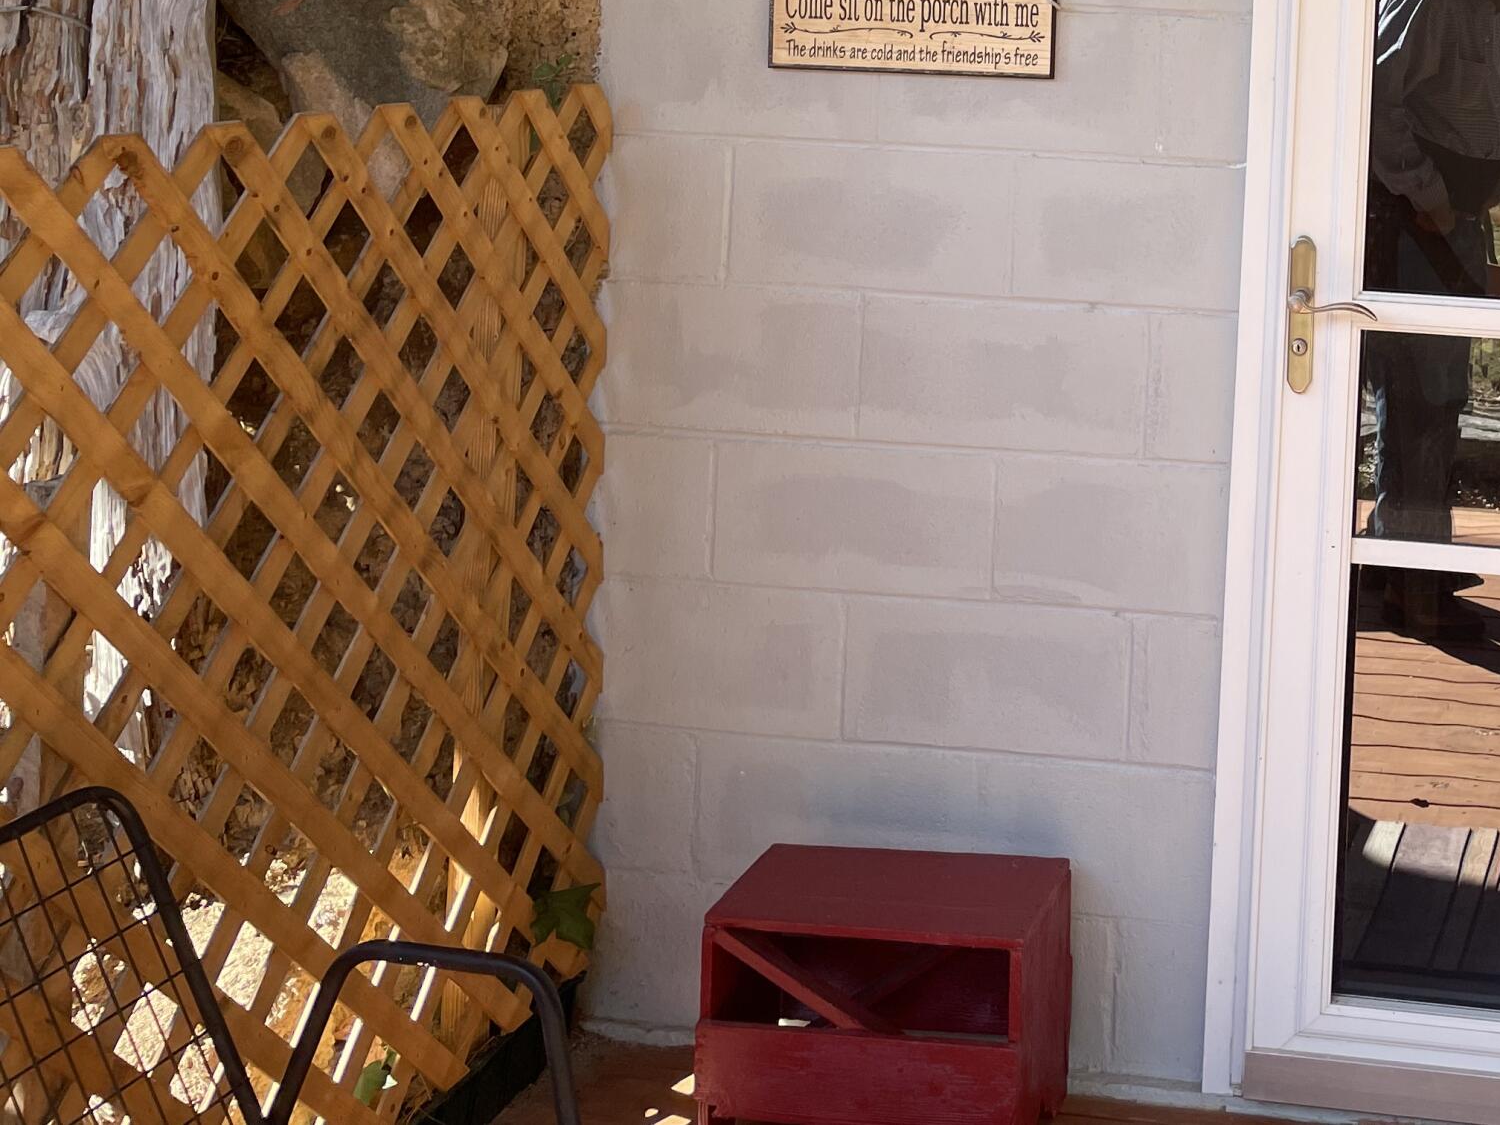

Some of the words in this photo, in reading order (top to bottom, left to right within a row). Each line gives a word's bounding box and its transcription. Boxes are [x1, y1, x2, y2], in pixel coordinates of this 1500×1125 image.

[1015, 3, 1039, 28] me
[786, 39, 806, 58] The
[809, 39, 846, 59] drinks
[849, 44, 867, 60] are
[870, 41, 894, 61] cold
[895, 43, 916, 62] and
[918, 45, 938, 63] the
[941, 41, 1011, 70] friendship's
[1014, 47, 1039, 67] free
